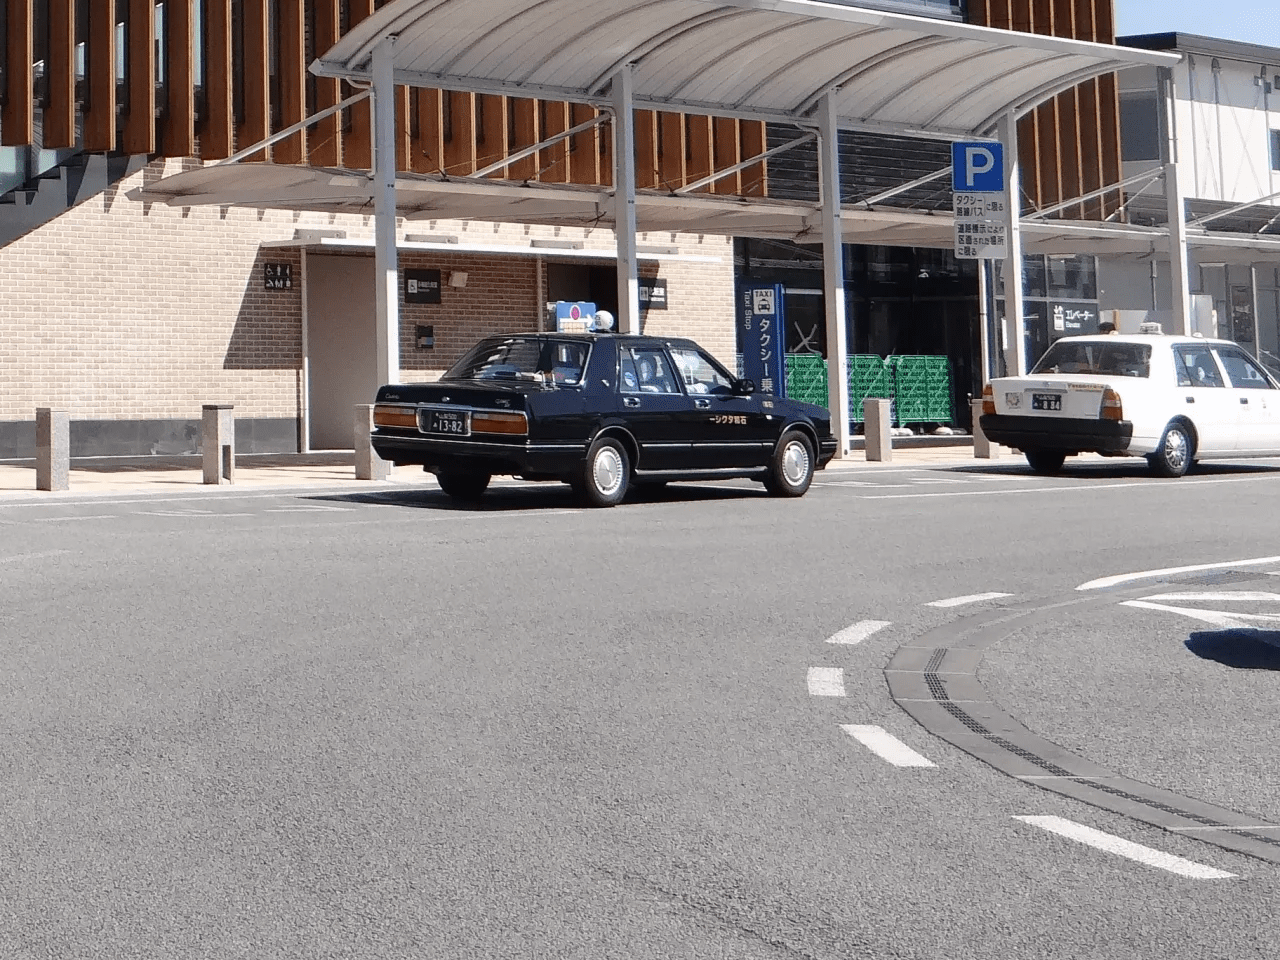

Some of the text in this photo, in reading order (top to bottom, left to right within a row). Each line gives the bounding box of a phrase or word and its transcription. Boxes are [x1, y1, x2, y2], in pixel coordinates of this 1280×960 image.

[966, 147, 995, 187] P
[956, 195, 983, 205] タクシー
[754, 290, 773, 298] TAXI
[744, 289, 753, 330] Taxi Stop
[1065, 310, 1095, 320] エレベーター
[759, 318, 774, 393] タクシー乗
